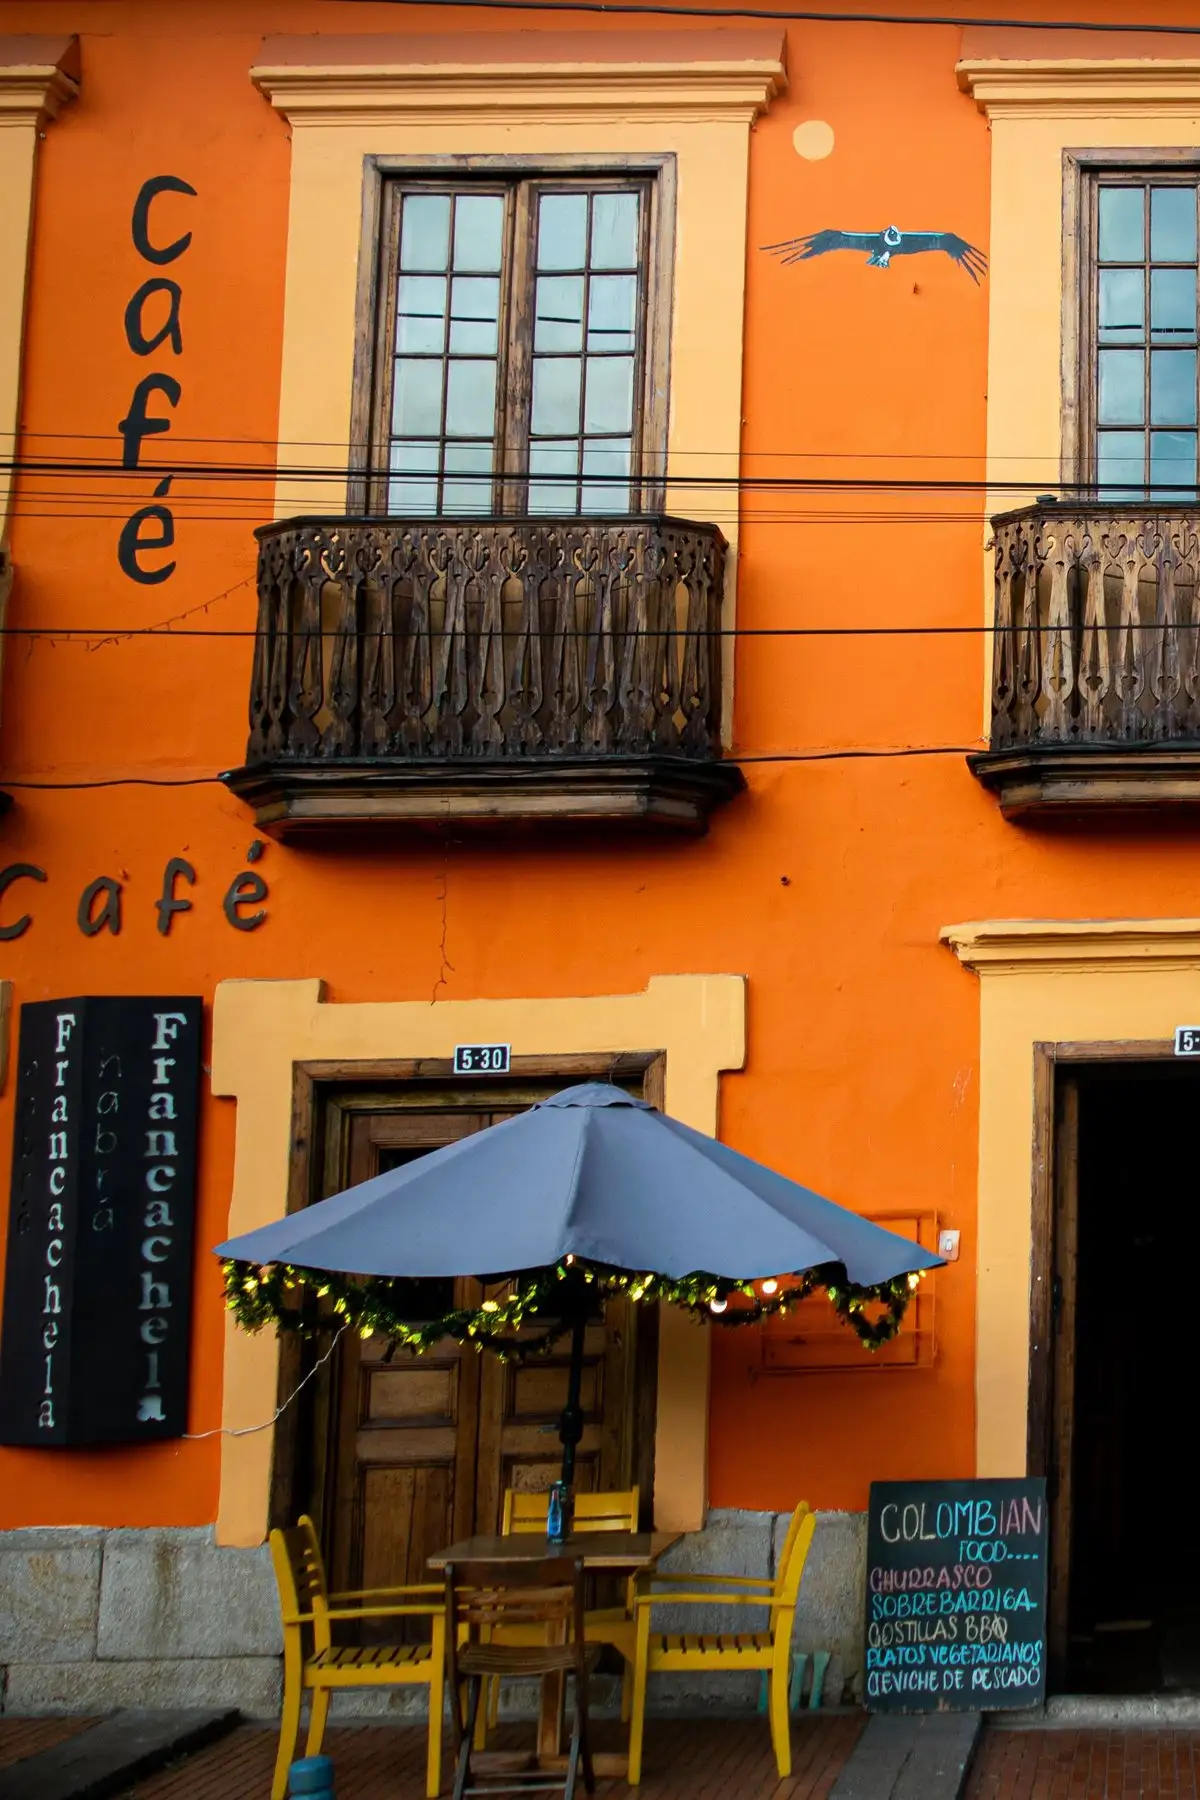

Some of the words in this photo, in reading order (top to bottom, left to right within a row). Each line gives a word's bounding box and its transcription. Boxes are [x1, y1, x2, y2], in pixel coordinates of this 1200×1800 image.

[118, 175, 198, 585] Café
[0, 839, 269, 942] Café
[462, 1048, 503, 1069] 5-30
[38, 1013, 76, 1428] Francachela
[136, 1012, 187, 1422] Francachela
[880, 1497, 1042, 1543] COLOMBIAN
[867, 1647, 926, 1669] PLATOS
[943, 1668, 964, 1691] DE
[971, 1666, 1041, 1692] PESCADO
